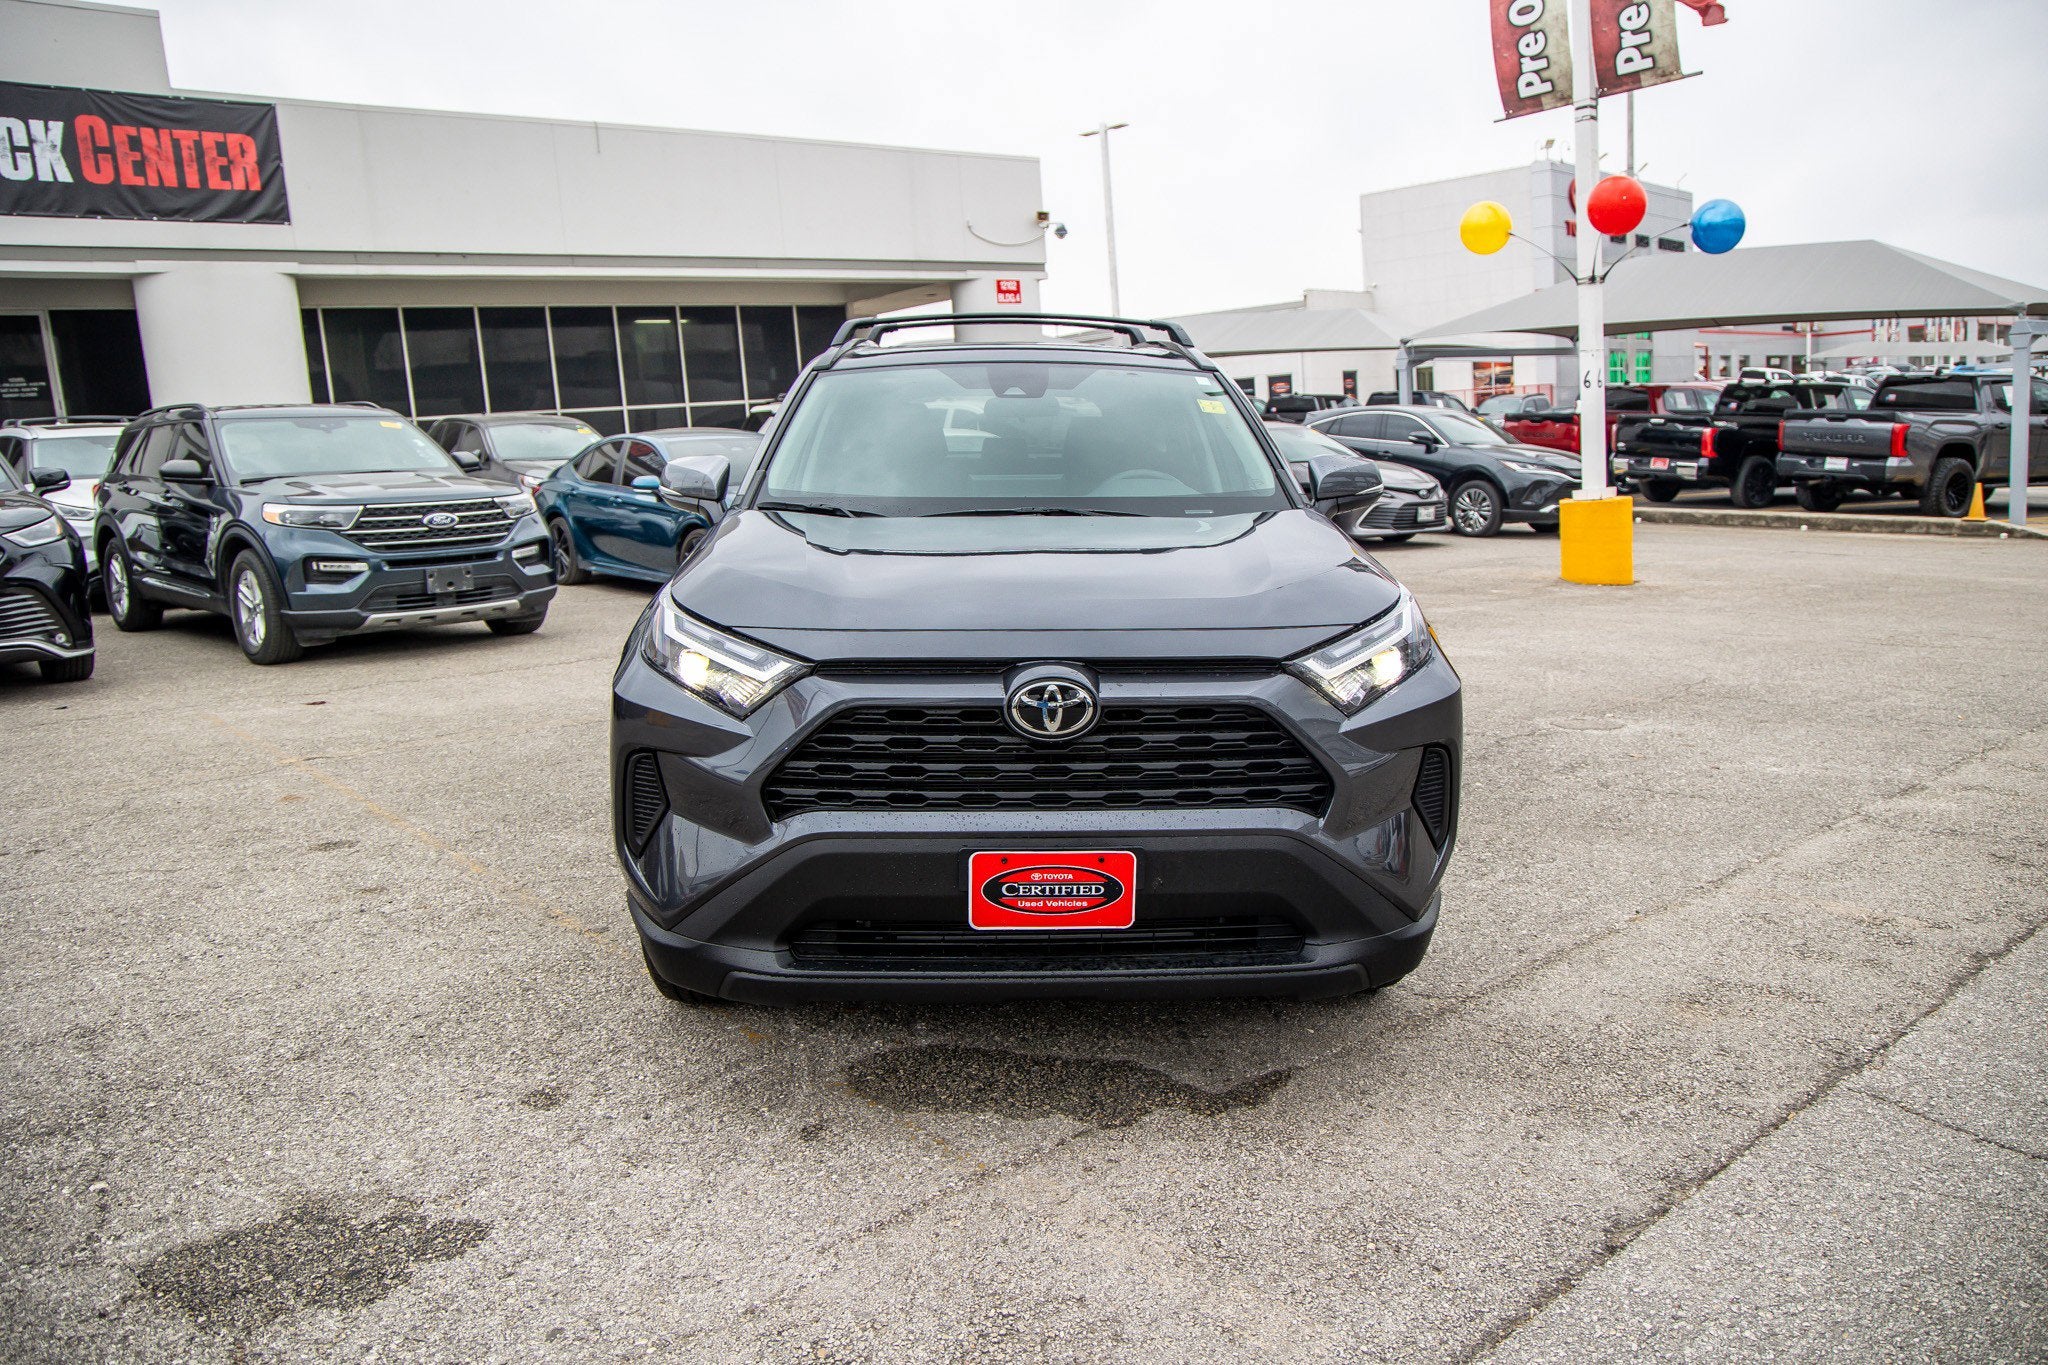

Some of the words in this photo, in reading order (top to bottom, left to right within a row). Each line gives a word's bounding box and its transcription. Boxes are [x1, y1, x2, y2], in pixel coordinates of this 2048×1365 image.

[1615, 2, 1655, 76] Pre
[74, 114, 262, 191] CENTER
[1018, 900, 1043, 908] Used
[1046, 900, 1088, 908] Vehicles
